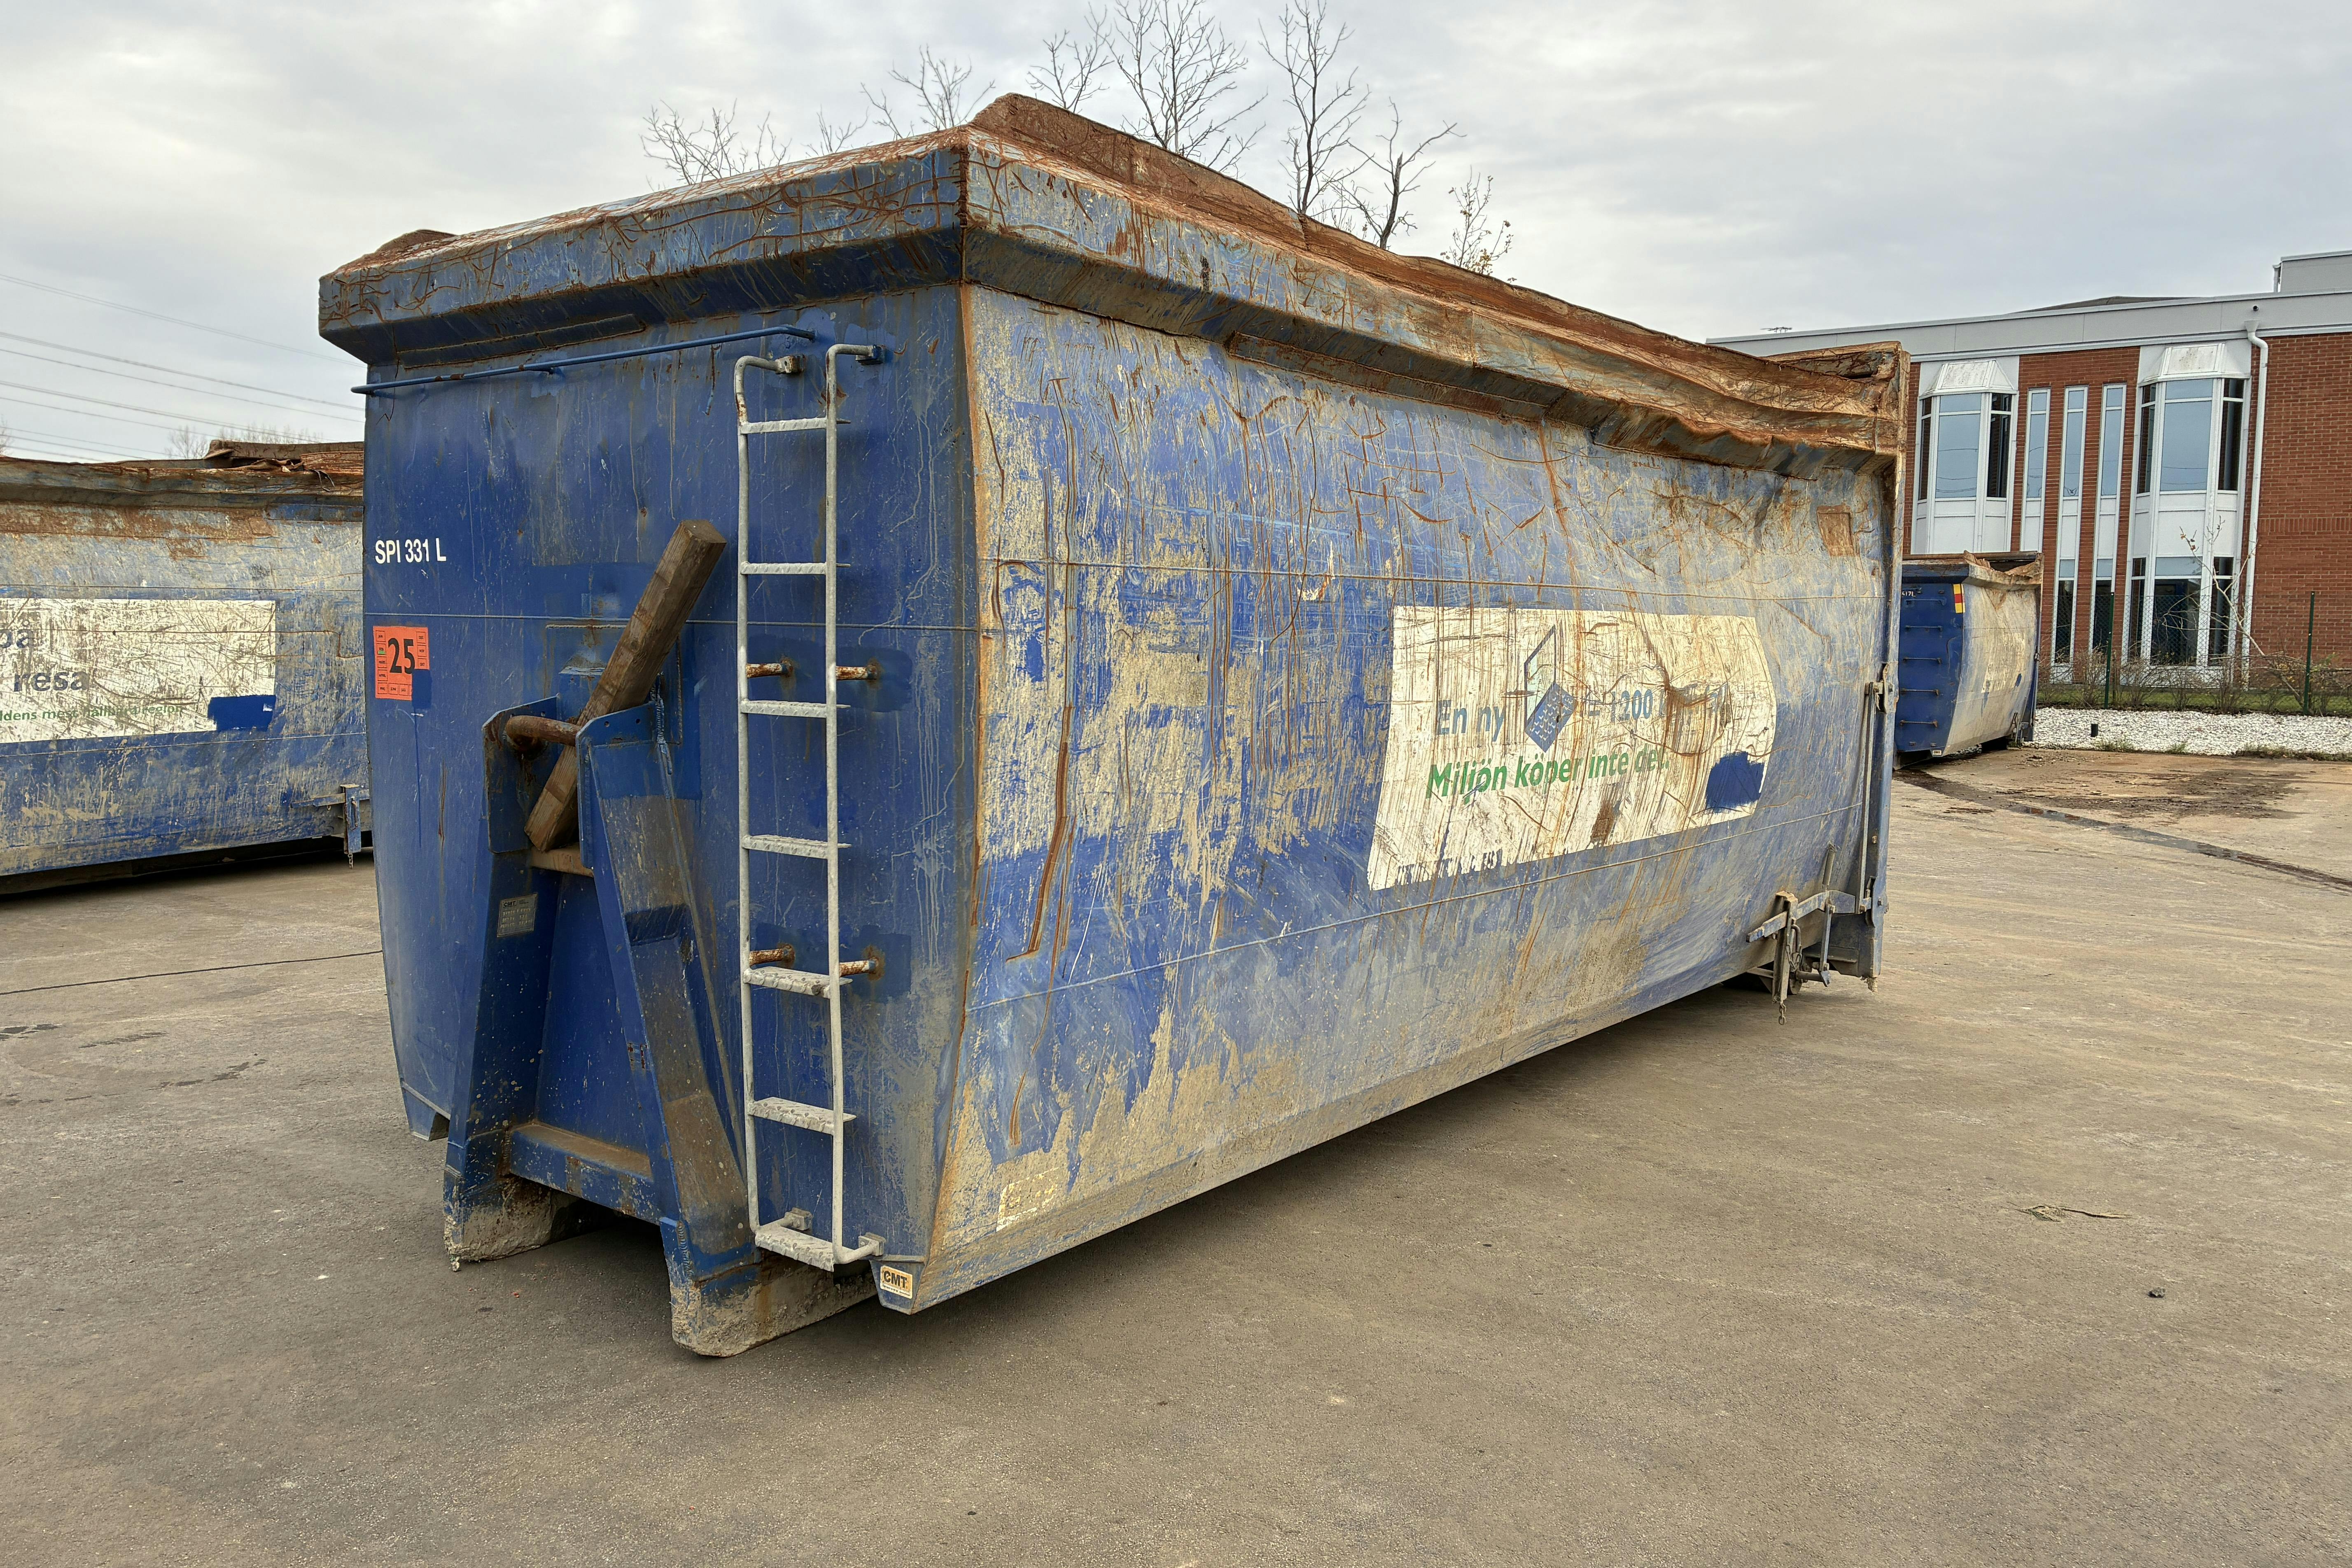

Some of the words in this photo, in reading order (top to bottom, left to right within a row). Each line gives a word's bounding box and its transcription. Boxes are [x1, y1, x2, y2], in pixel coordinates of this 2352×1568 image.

[375, 540, 401, 564] SPI
[405, 539, 429, 562] 331
[436, 538, 446, 561] L
[388, 638, 415, 674] 25
[14, 672, 89, 692] resa
[1436, 700, 1468, 735] En
[1476, 705, 1506, 742] ny
[1426, 758, 1507, 805] Miljön
[1514, 753, 1584, 795] köper
[1588, 749, 1629, 779] inte
[884, 1270, 907, 1288] CMT
